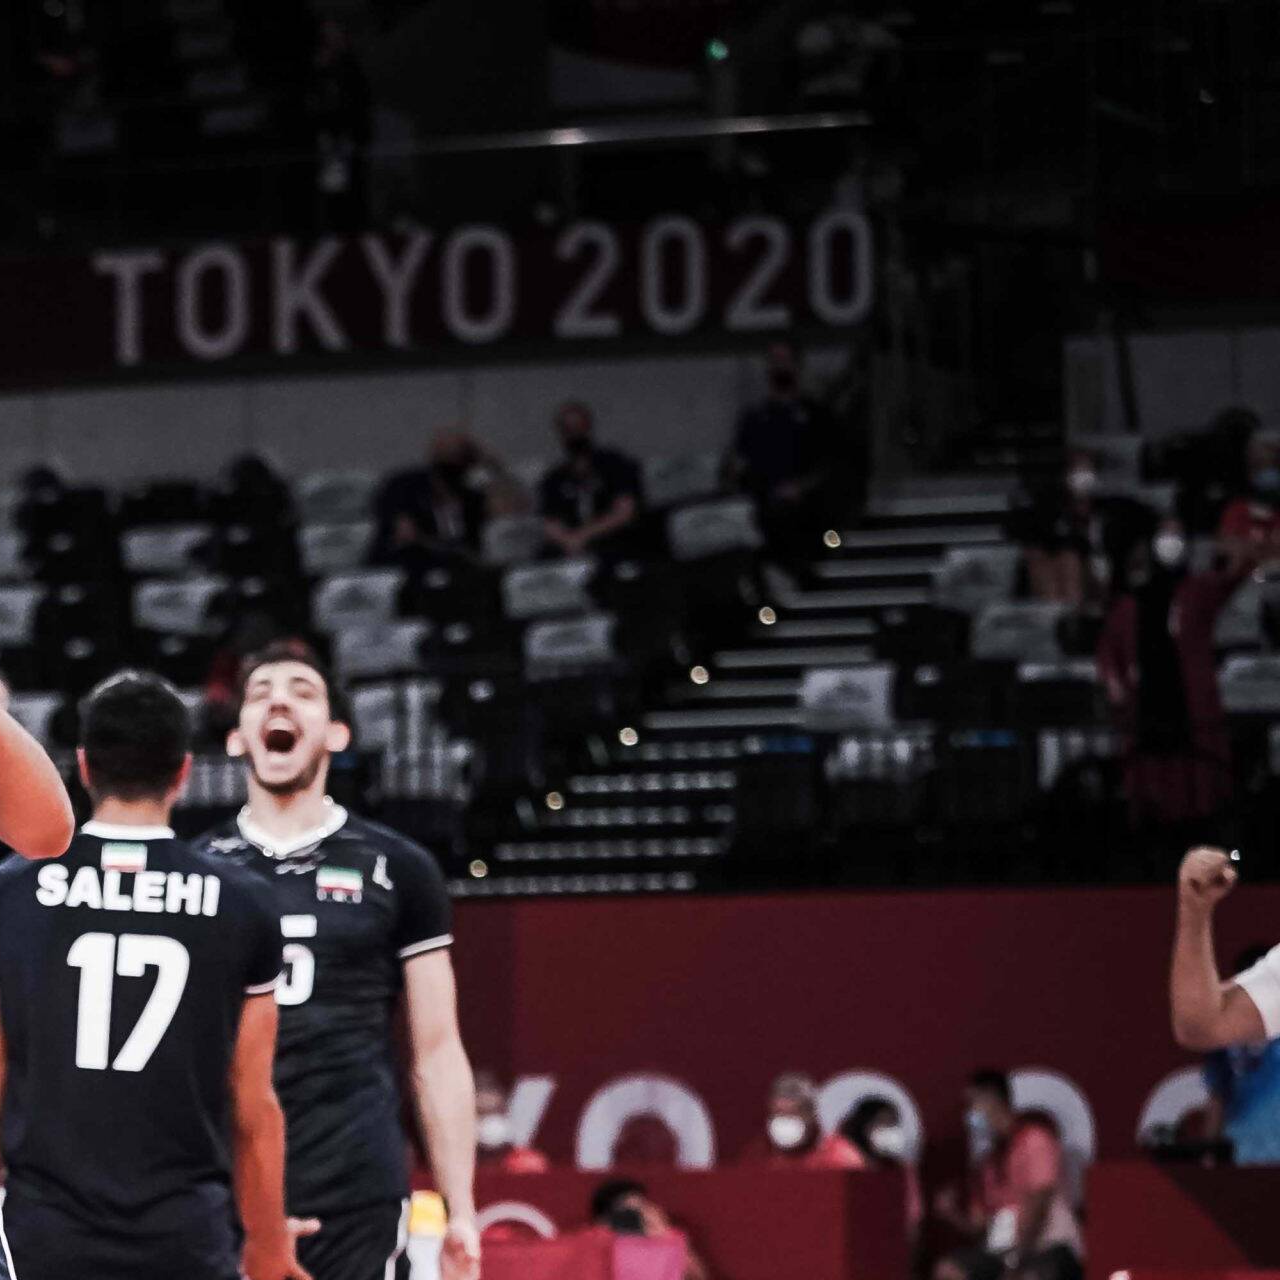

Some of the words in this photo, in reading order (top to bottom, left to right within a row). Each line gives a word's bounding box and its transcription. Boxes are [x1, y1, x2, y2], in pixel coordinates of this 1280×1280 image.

[93, 226, 518, 365] TOKYO
[554, 209, 876, 340] 2020
[36, 864, 220, 917] SALEHI
[66, 931, 191, 1073] 17
